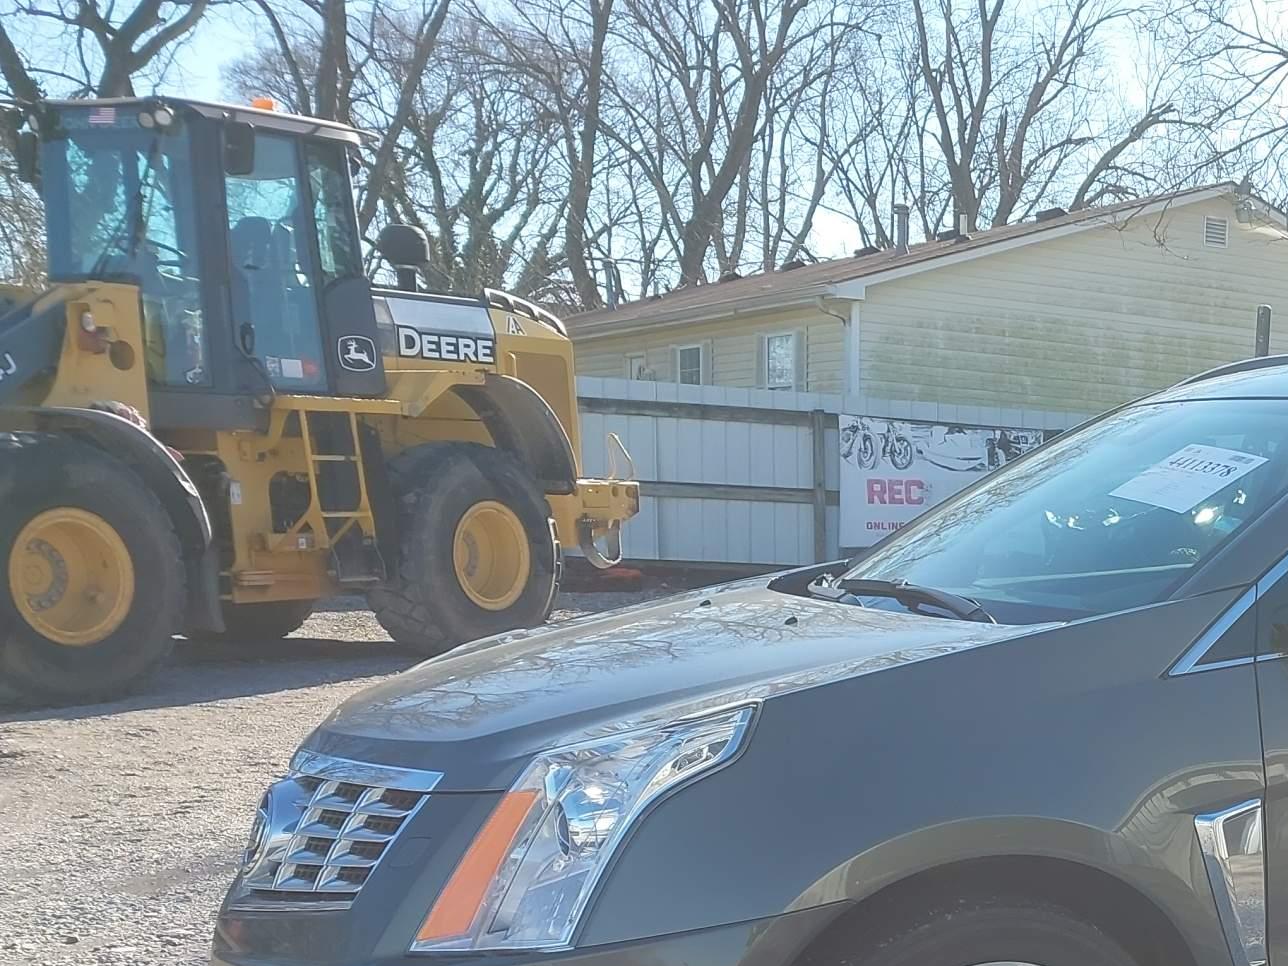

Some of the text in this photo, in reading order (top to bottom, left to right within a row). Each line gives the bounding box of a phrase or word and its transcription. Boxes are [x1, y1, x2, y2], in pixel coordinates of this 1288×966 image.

[398, 327, 494, 363] DEERE
[1169, 456, 1238, 478] 44113378
[866, 479, 924, 505] REC
